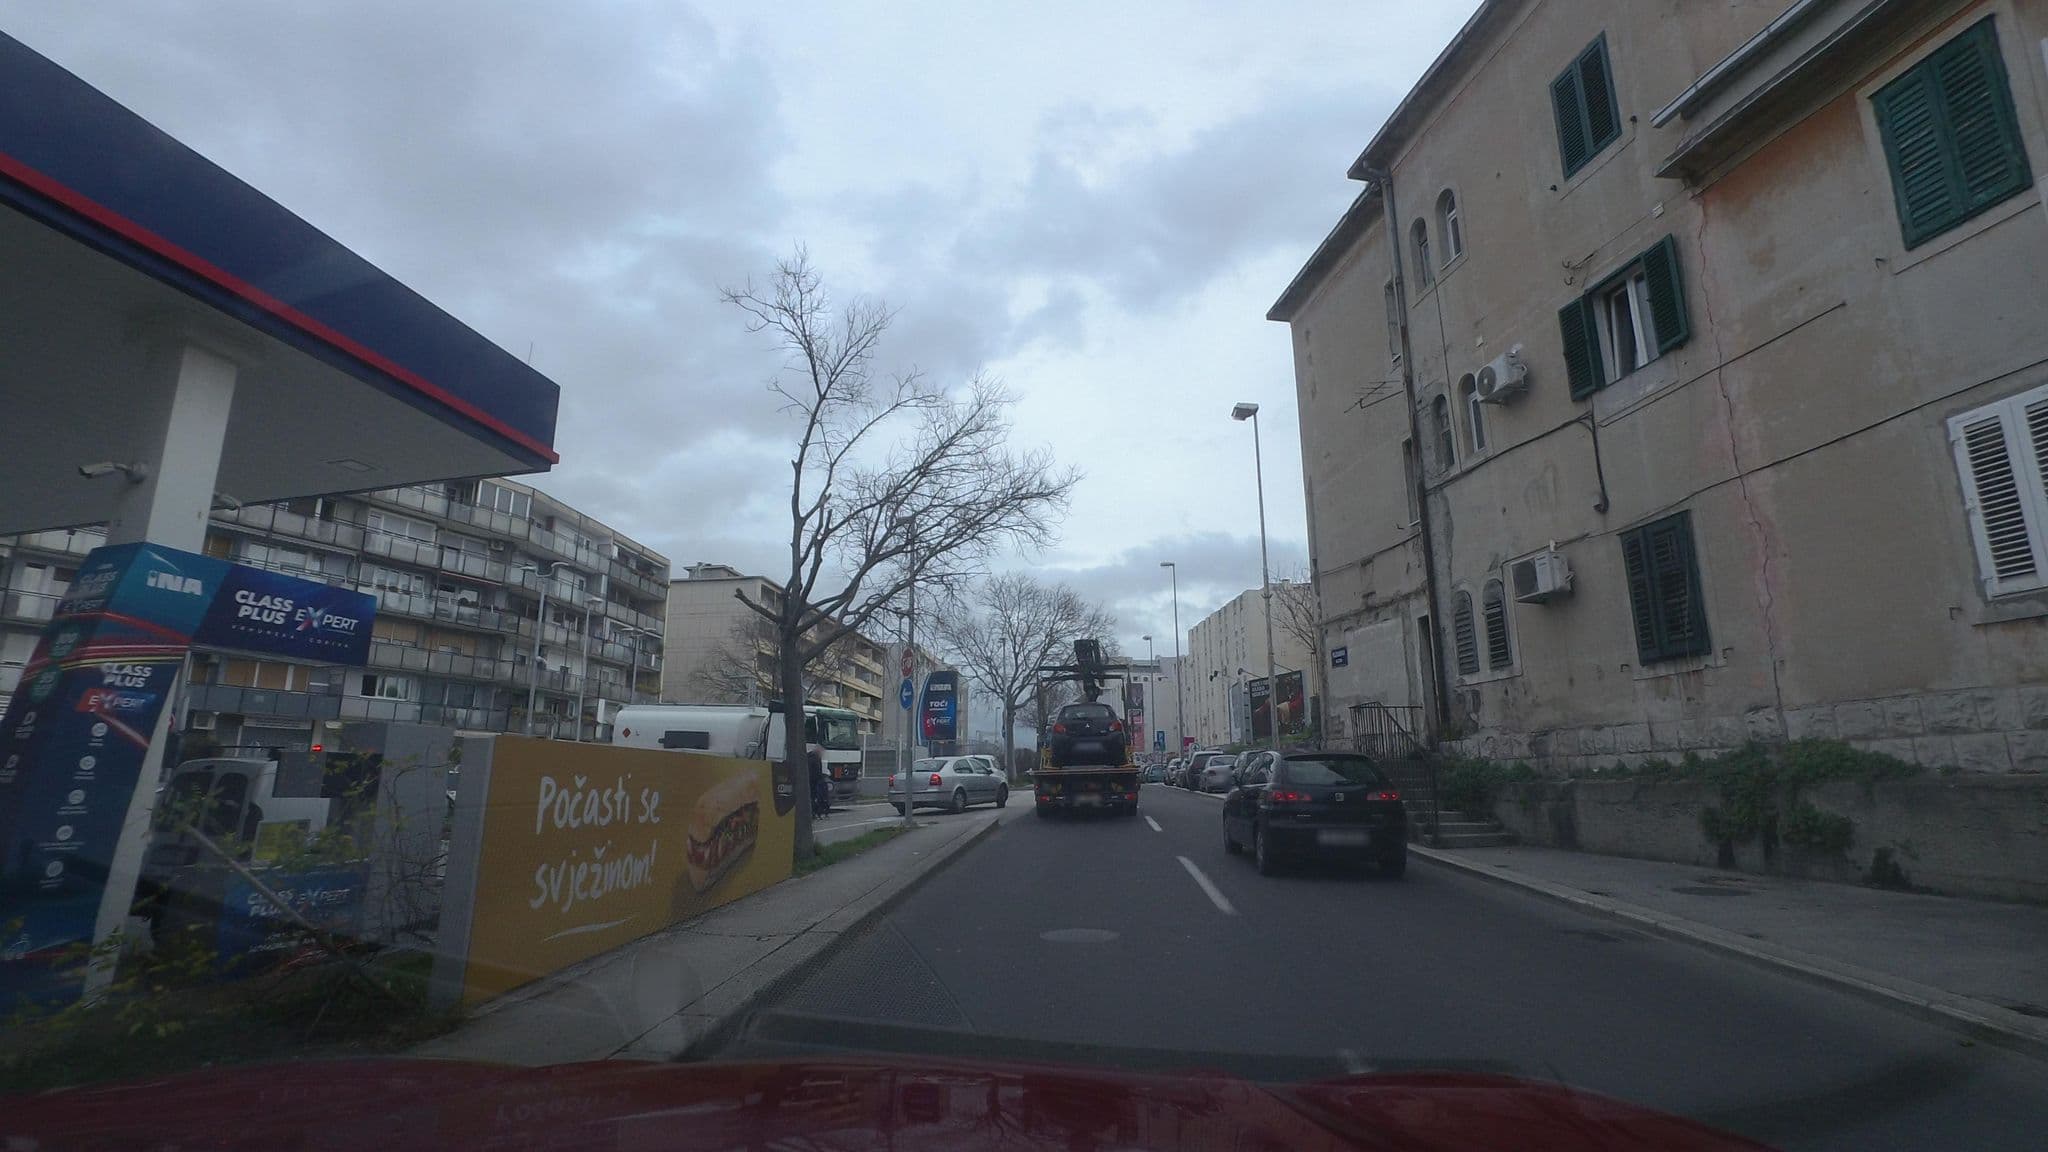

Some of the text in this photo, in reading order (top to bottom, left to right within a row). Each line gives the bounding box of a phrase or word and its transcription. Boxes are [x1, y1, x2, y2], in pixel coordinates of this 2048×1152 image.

[235, 589, 294, 612] CLASS
[238, 605, 287, 625] PLUS
[294, 606, 360, 631] EXPERT
[100, 663, 153, 677] CLASS
[102, 675, 147, 688] PLUS
[535, 773, 661, 835] Počasti se
[529, 839, 658, 914] svježinom!
